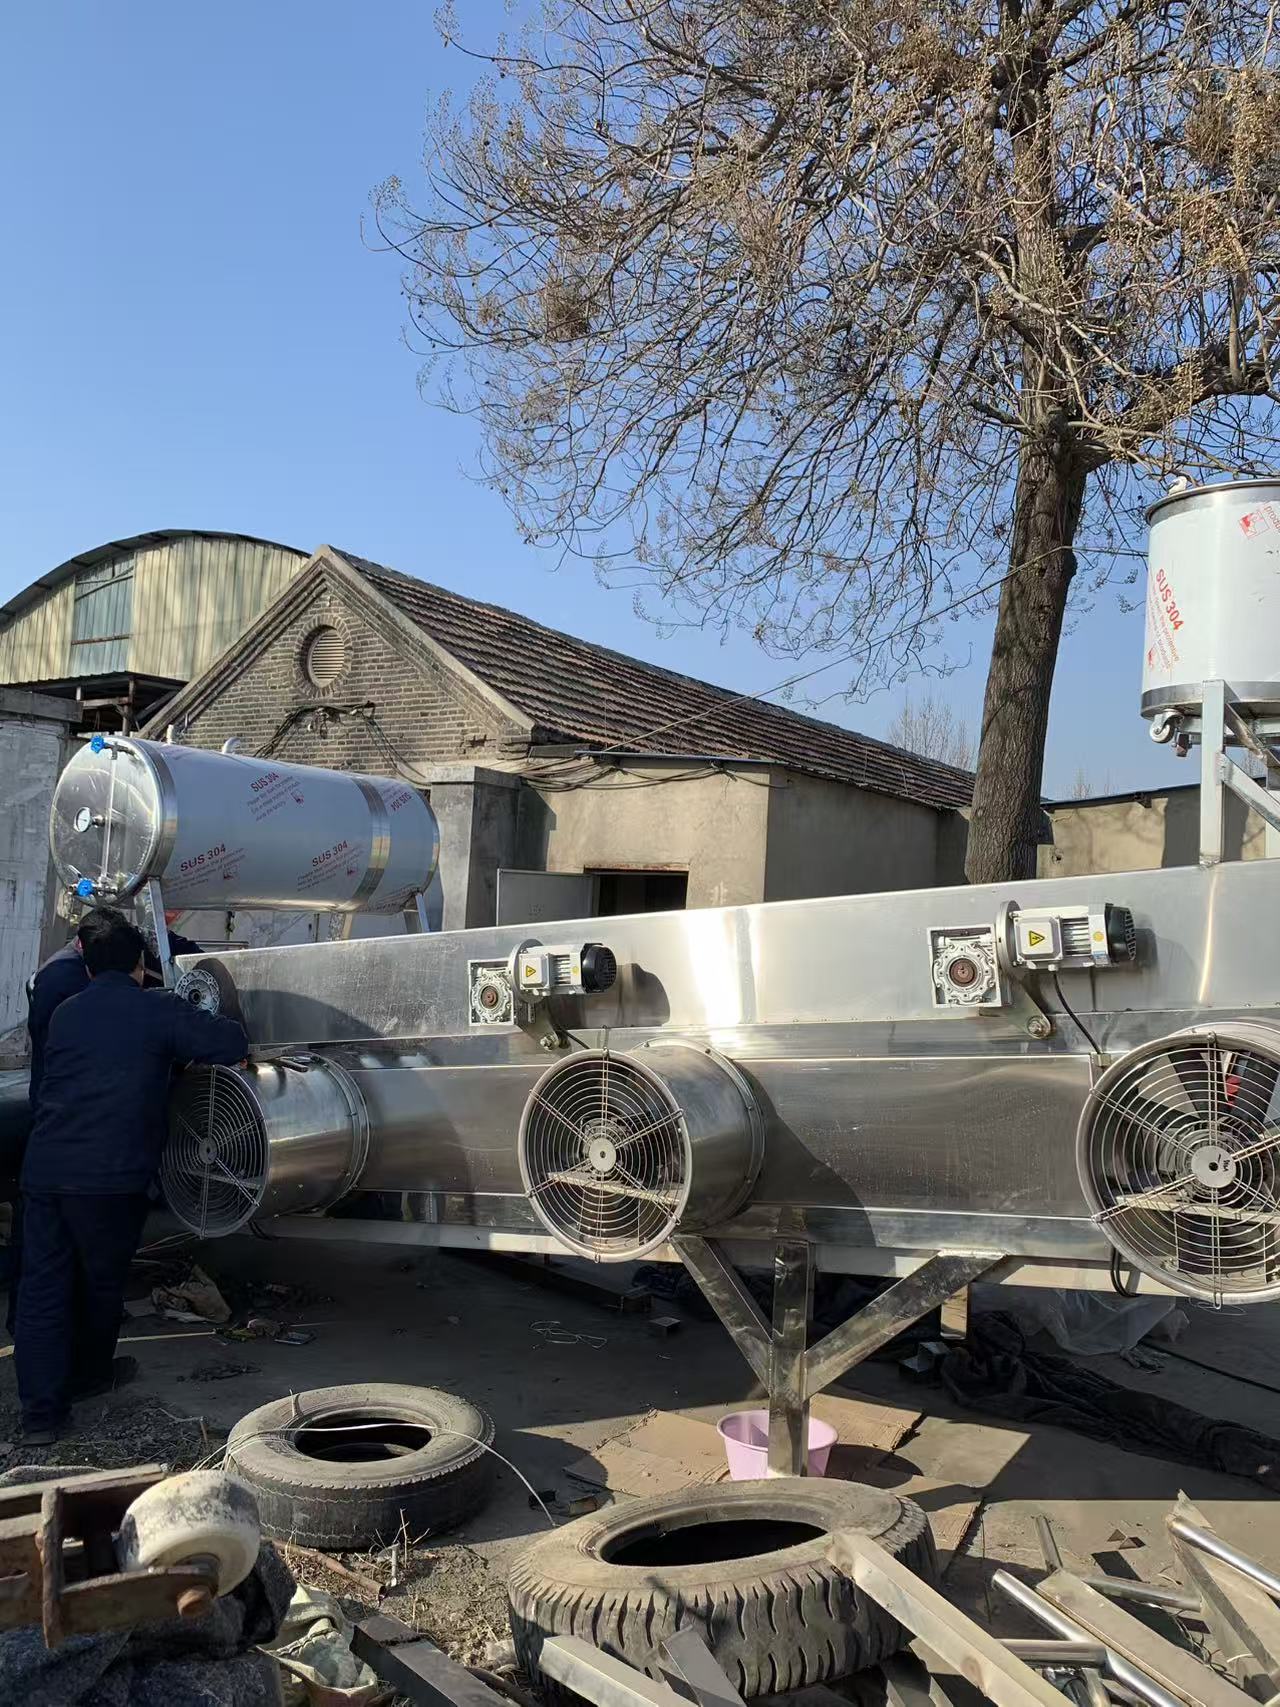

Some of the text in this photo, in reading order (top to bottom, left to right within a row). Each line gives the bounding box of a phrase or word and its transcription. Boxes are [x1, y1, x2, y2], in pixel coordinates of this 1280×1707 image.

[1156, 568, 1171, 602] SUS
[1165, 601, 1184, 630] 304
[250, 777, 269, 792] SUS
[180, 843, 226, 872] SUS 304
[312, 840, 348, 867] SUS 304
